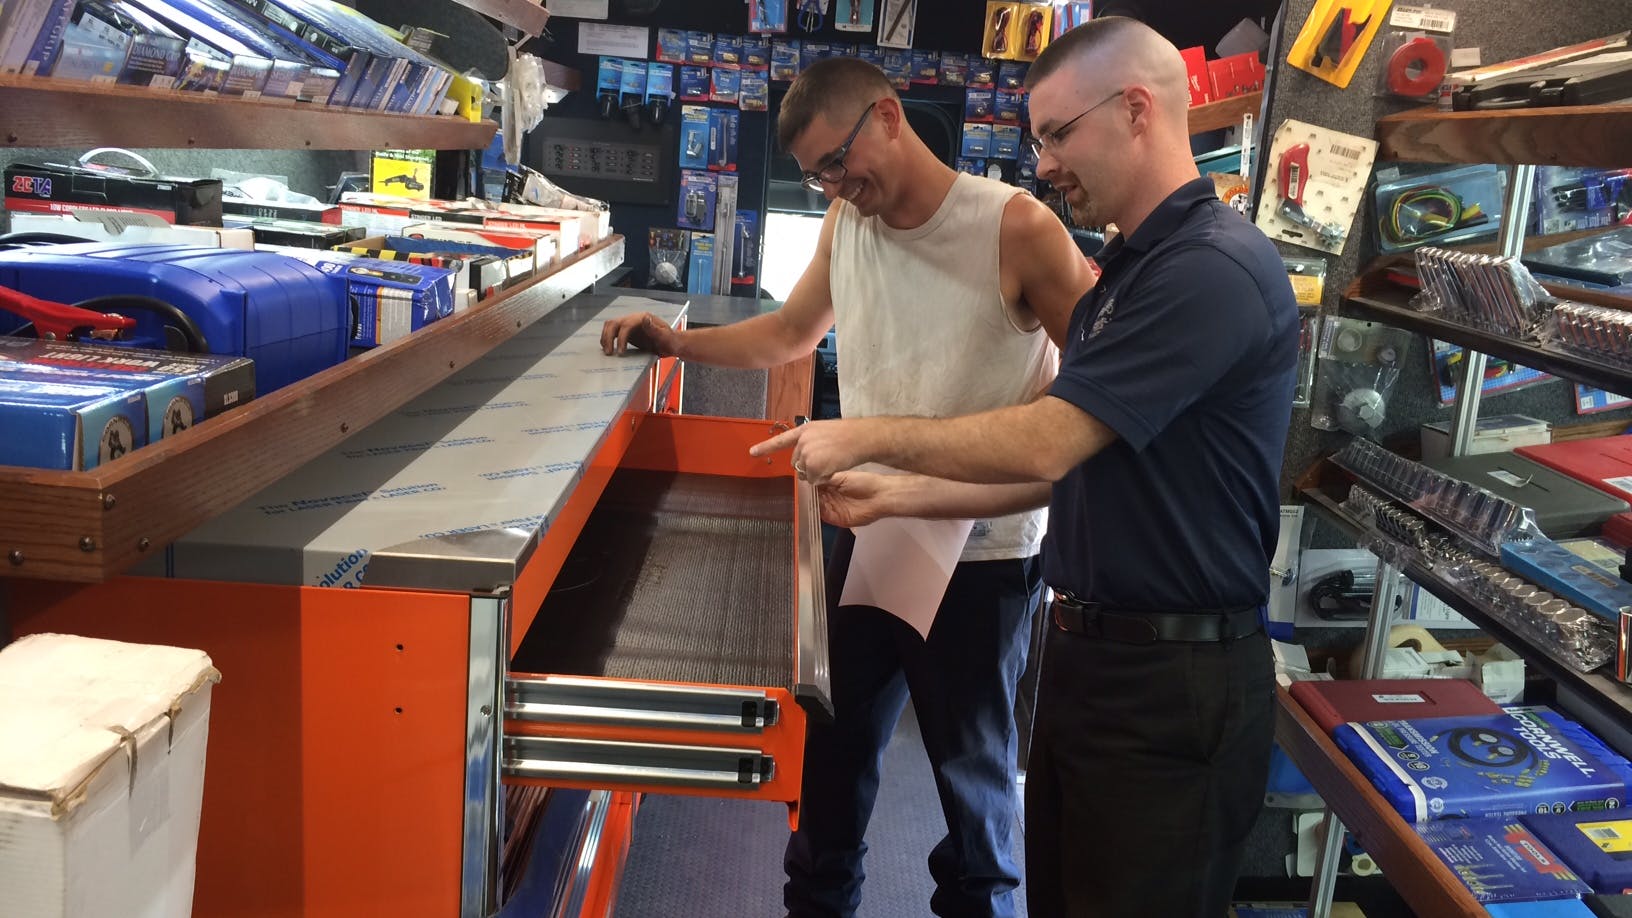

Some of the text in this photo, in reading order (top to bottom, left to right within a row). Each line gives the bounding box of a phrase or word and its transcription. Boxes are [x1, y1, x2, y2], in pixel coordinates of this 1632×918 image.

[13, 175, 52, 195] ZETA
[39, 351, 101, 363] LIGHT
[318, 549, 368, 588] olution
[1510, 712, 1596, 777] CORNWELL
[1513, 726, 1562, 759] TOOLS
